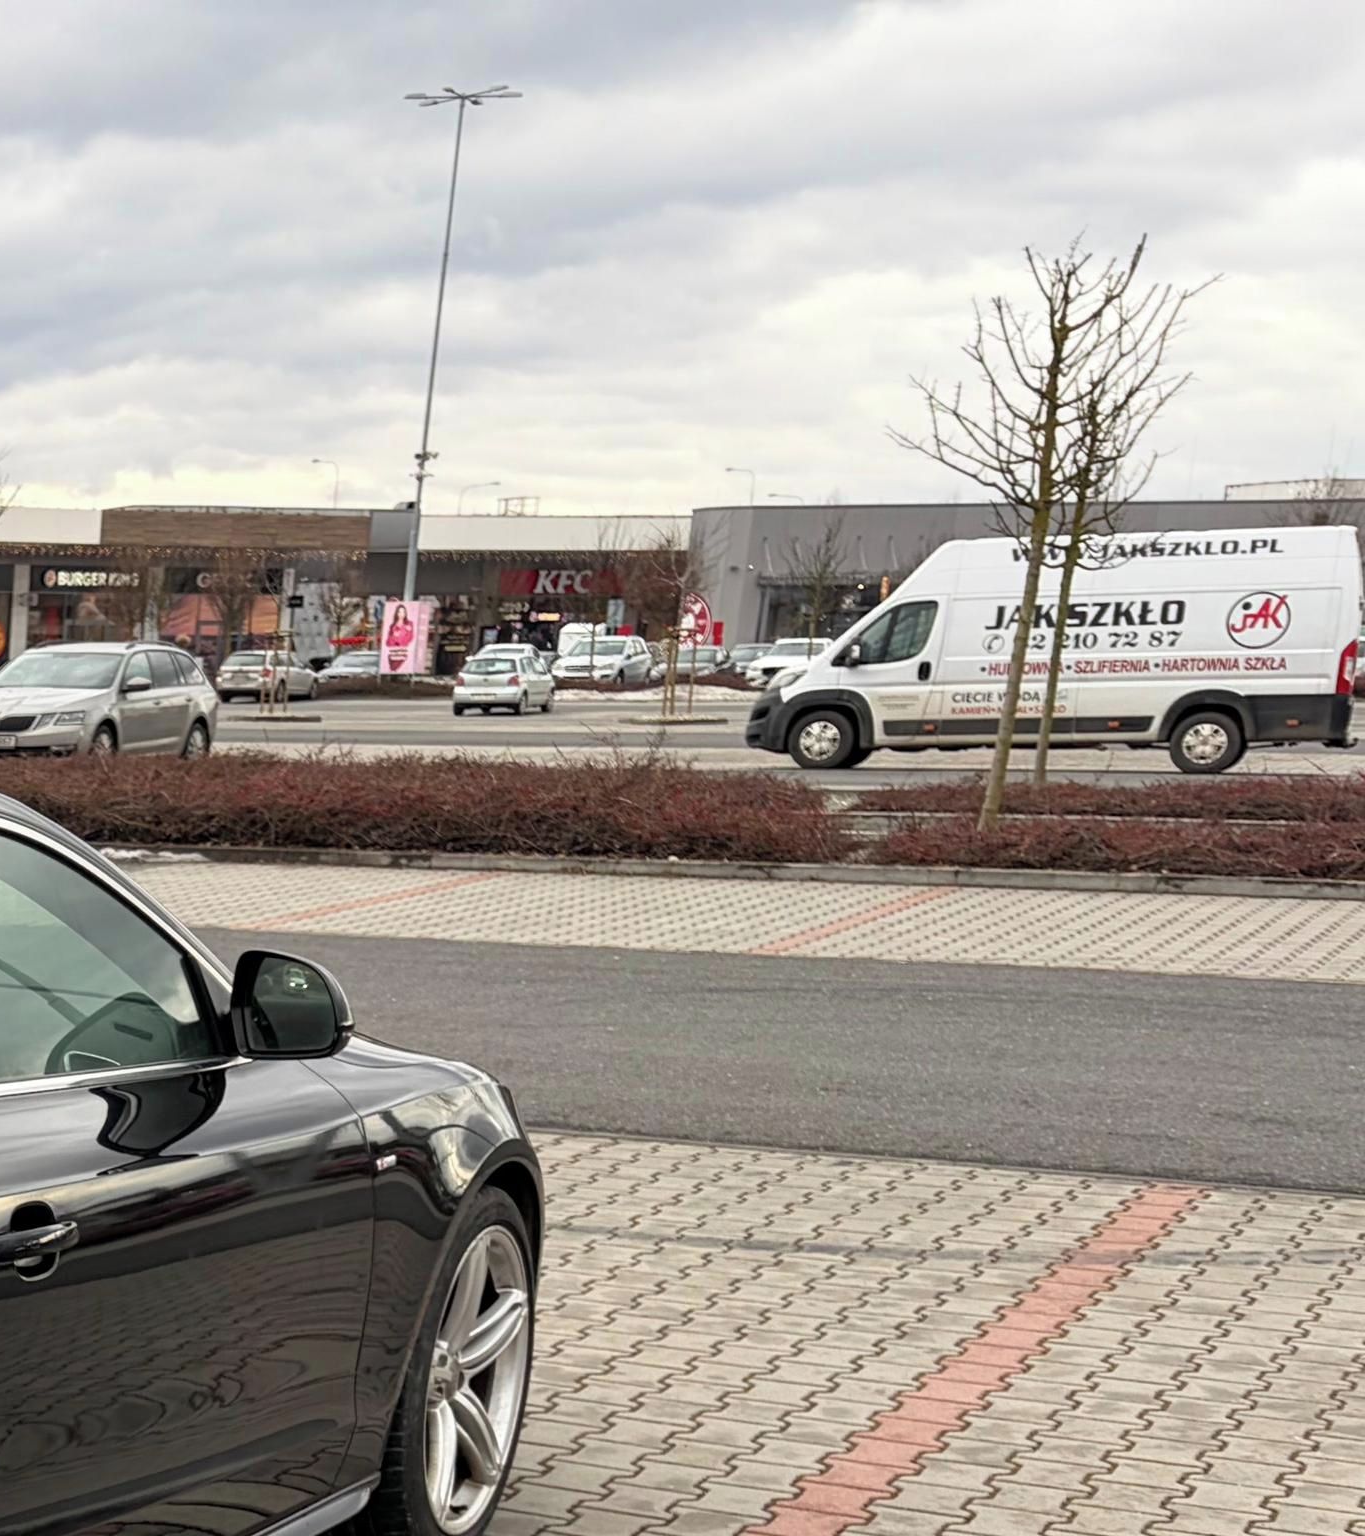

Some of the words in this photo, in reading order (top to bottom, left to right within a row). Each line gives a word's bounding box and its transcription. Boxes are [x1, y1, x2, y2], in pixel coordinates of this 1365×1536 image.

[57, 571, 107, 587] BURGER
[533, 569, 593, 595] KFC
[1108, 632, 1139, 649] 72
[1148, 631, 1183, 648] 87
[1073, 658, 1151, 674] SZLIFIERNIA
[1161, 657, 1240, 673] HARTOWNIA
